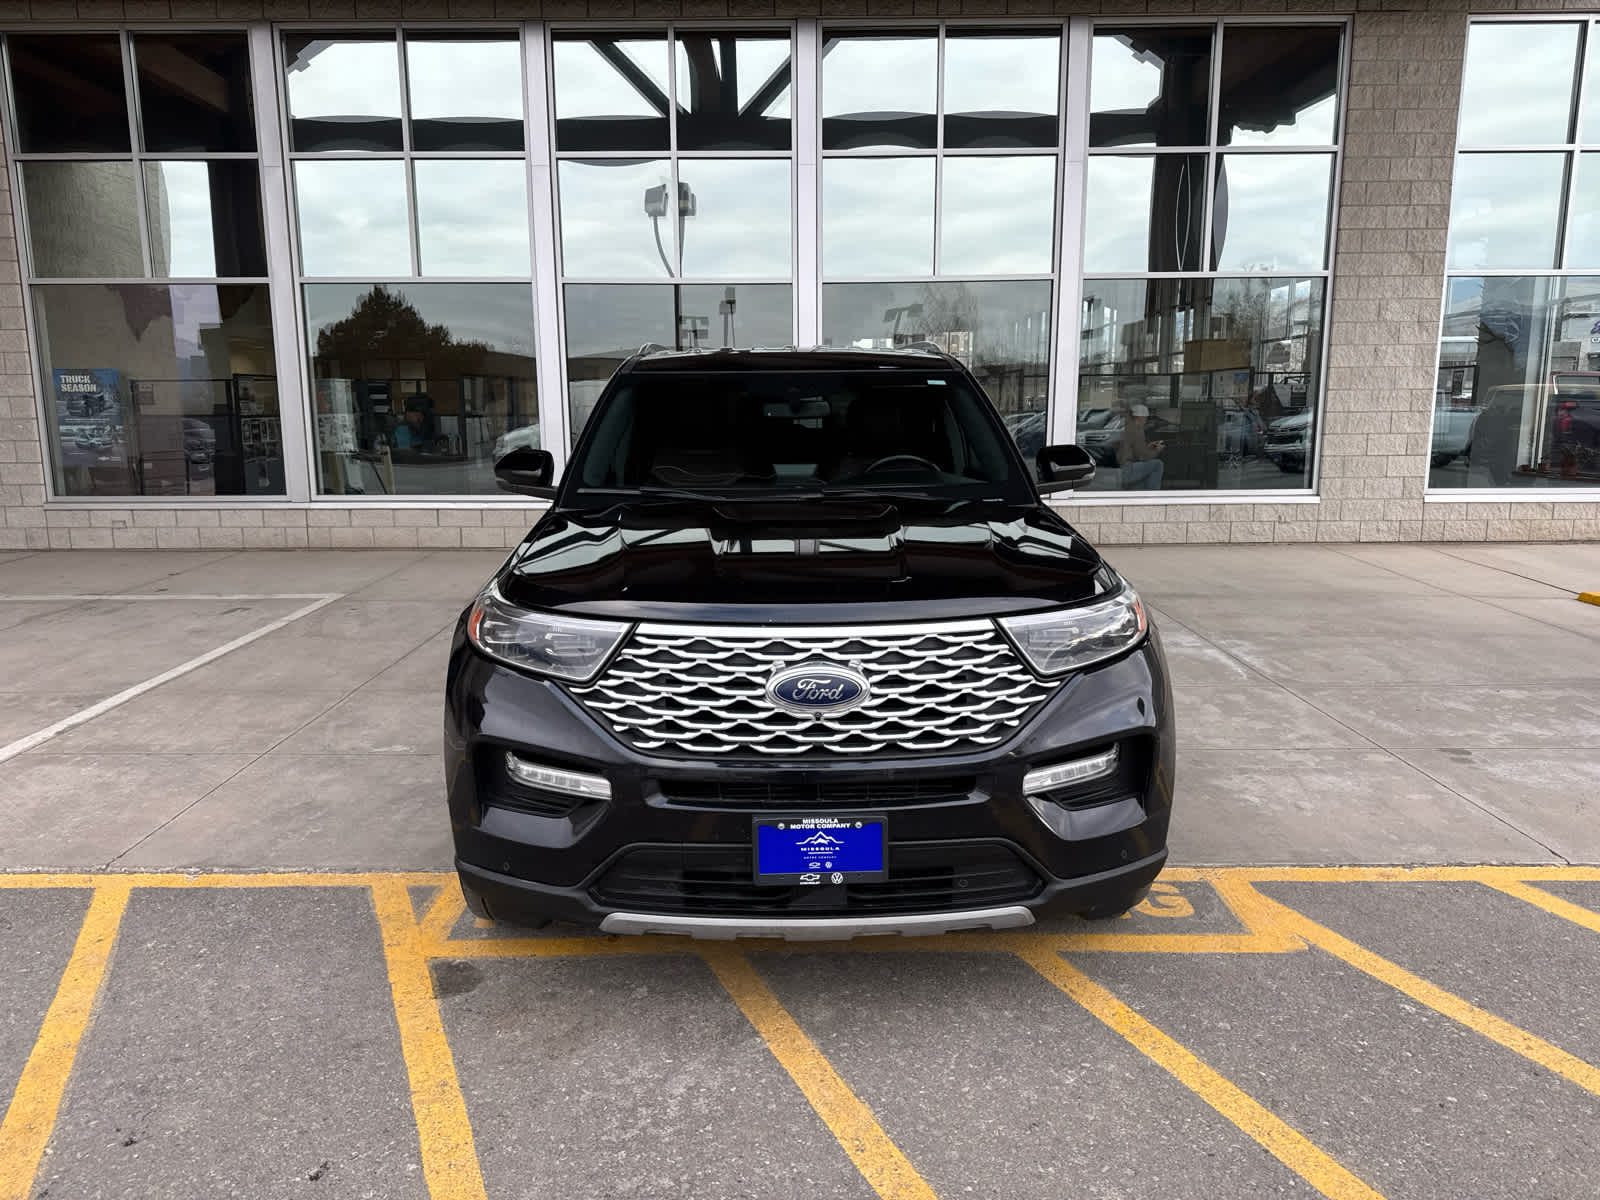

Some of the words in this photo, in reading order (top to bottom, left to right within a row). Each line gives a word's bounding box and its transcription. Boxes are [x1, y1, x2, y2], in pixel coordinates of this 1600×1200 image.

[60, 375, 91, 383] TRUCK
[61, 384, 97, 392] SEASON
[792, 678, 844, 701] Ford
